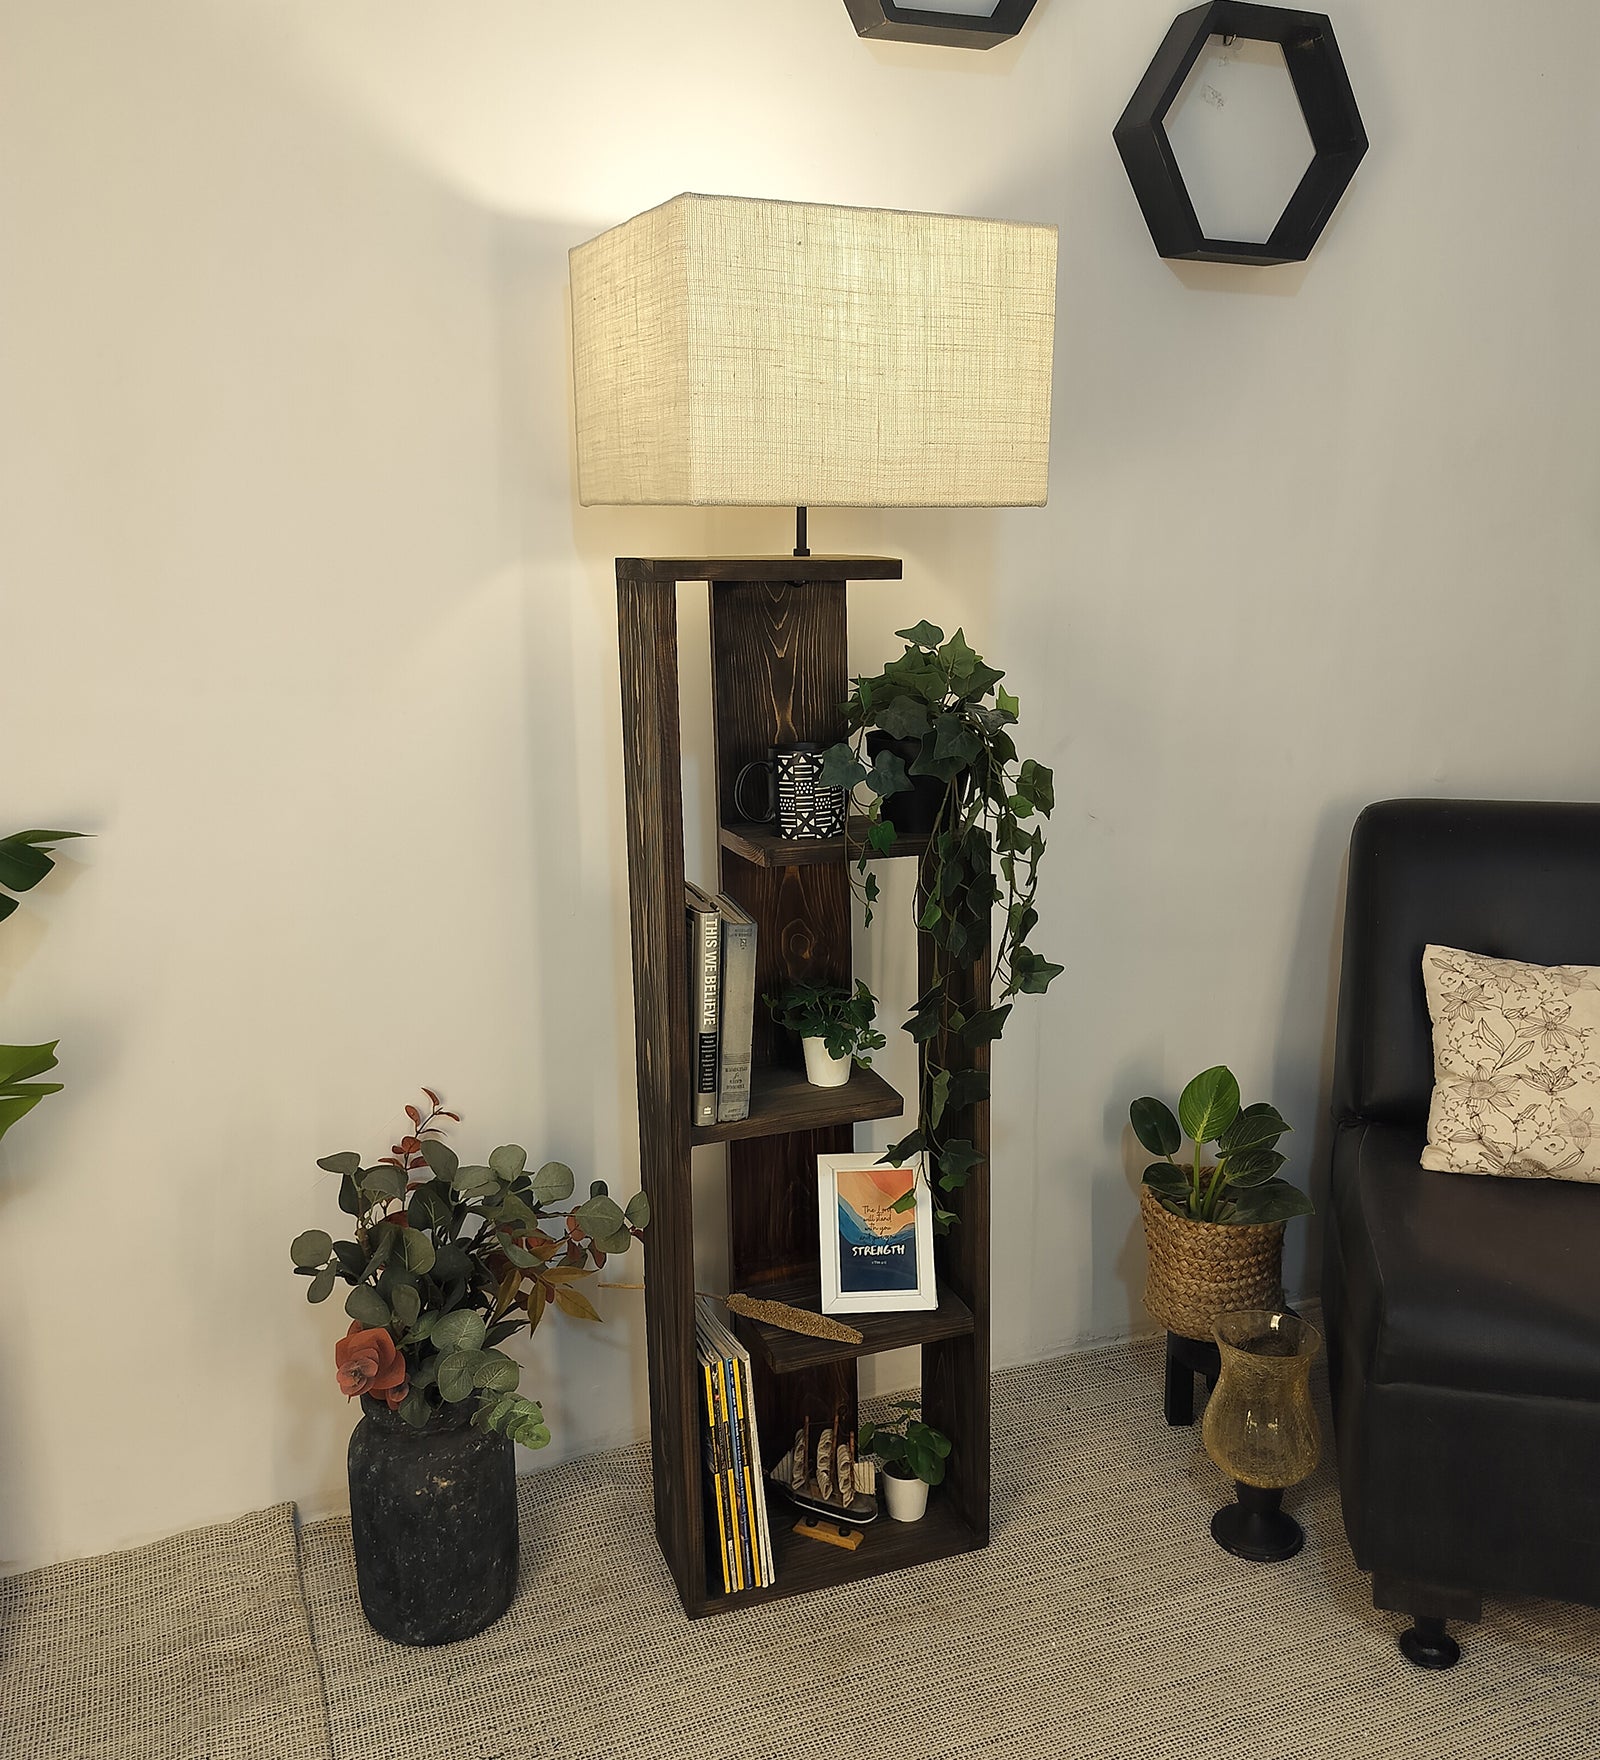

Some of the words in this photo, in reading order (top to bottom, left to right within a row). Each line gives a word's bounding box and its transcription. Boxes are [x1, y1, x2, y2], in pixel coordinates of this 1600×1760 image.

[704, 918, 718, 948] THIS
[704, 950, 718, 973] WE
[703, 975, 717, 1026] BELIEVE
[862, 1205, 876, 1214] The
[852, 1245, 905, 1256] STRENGTH
